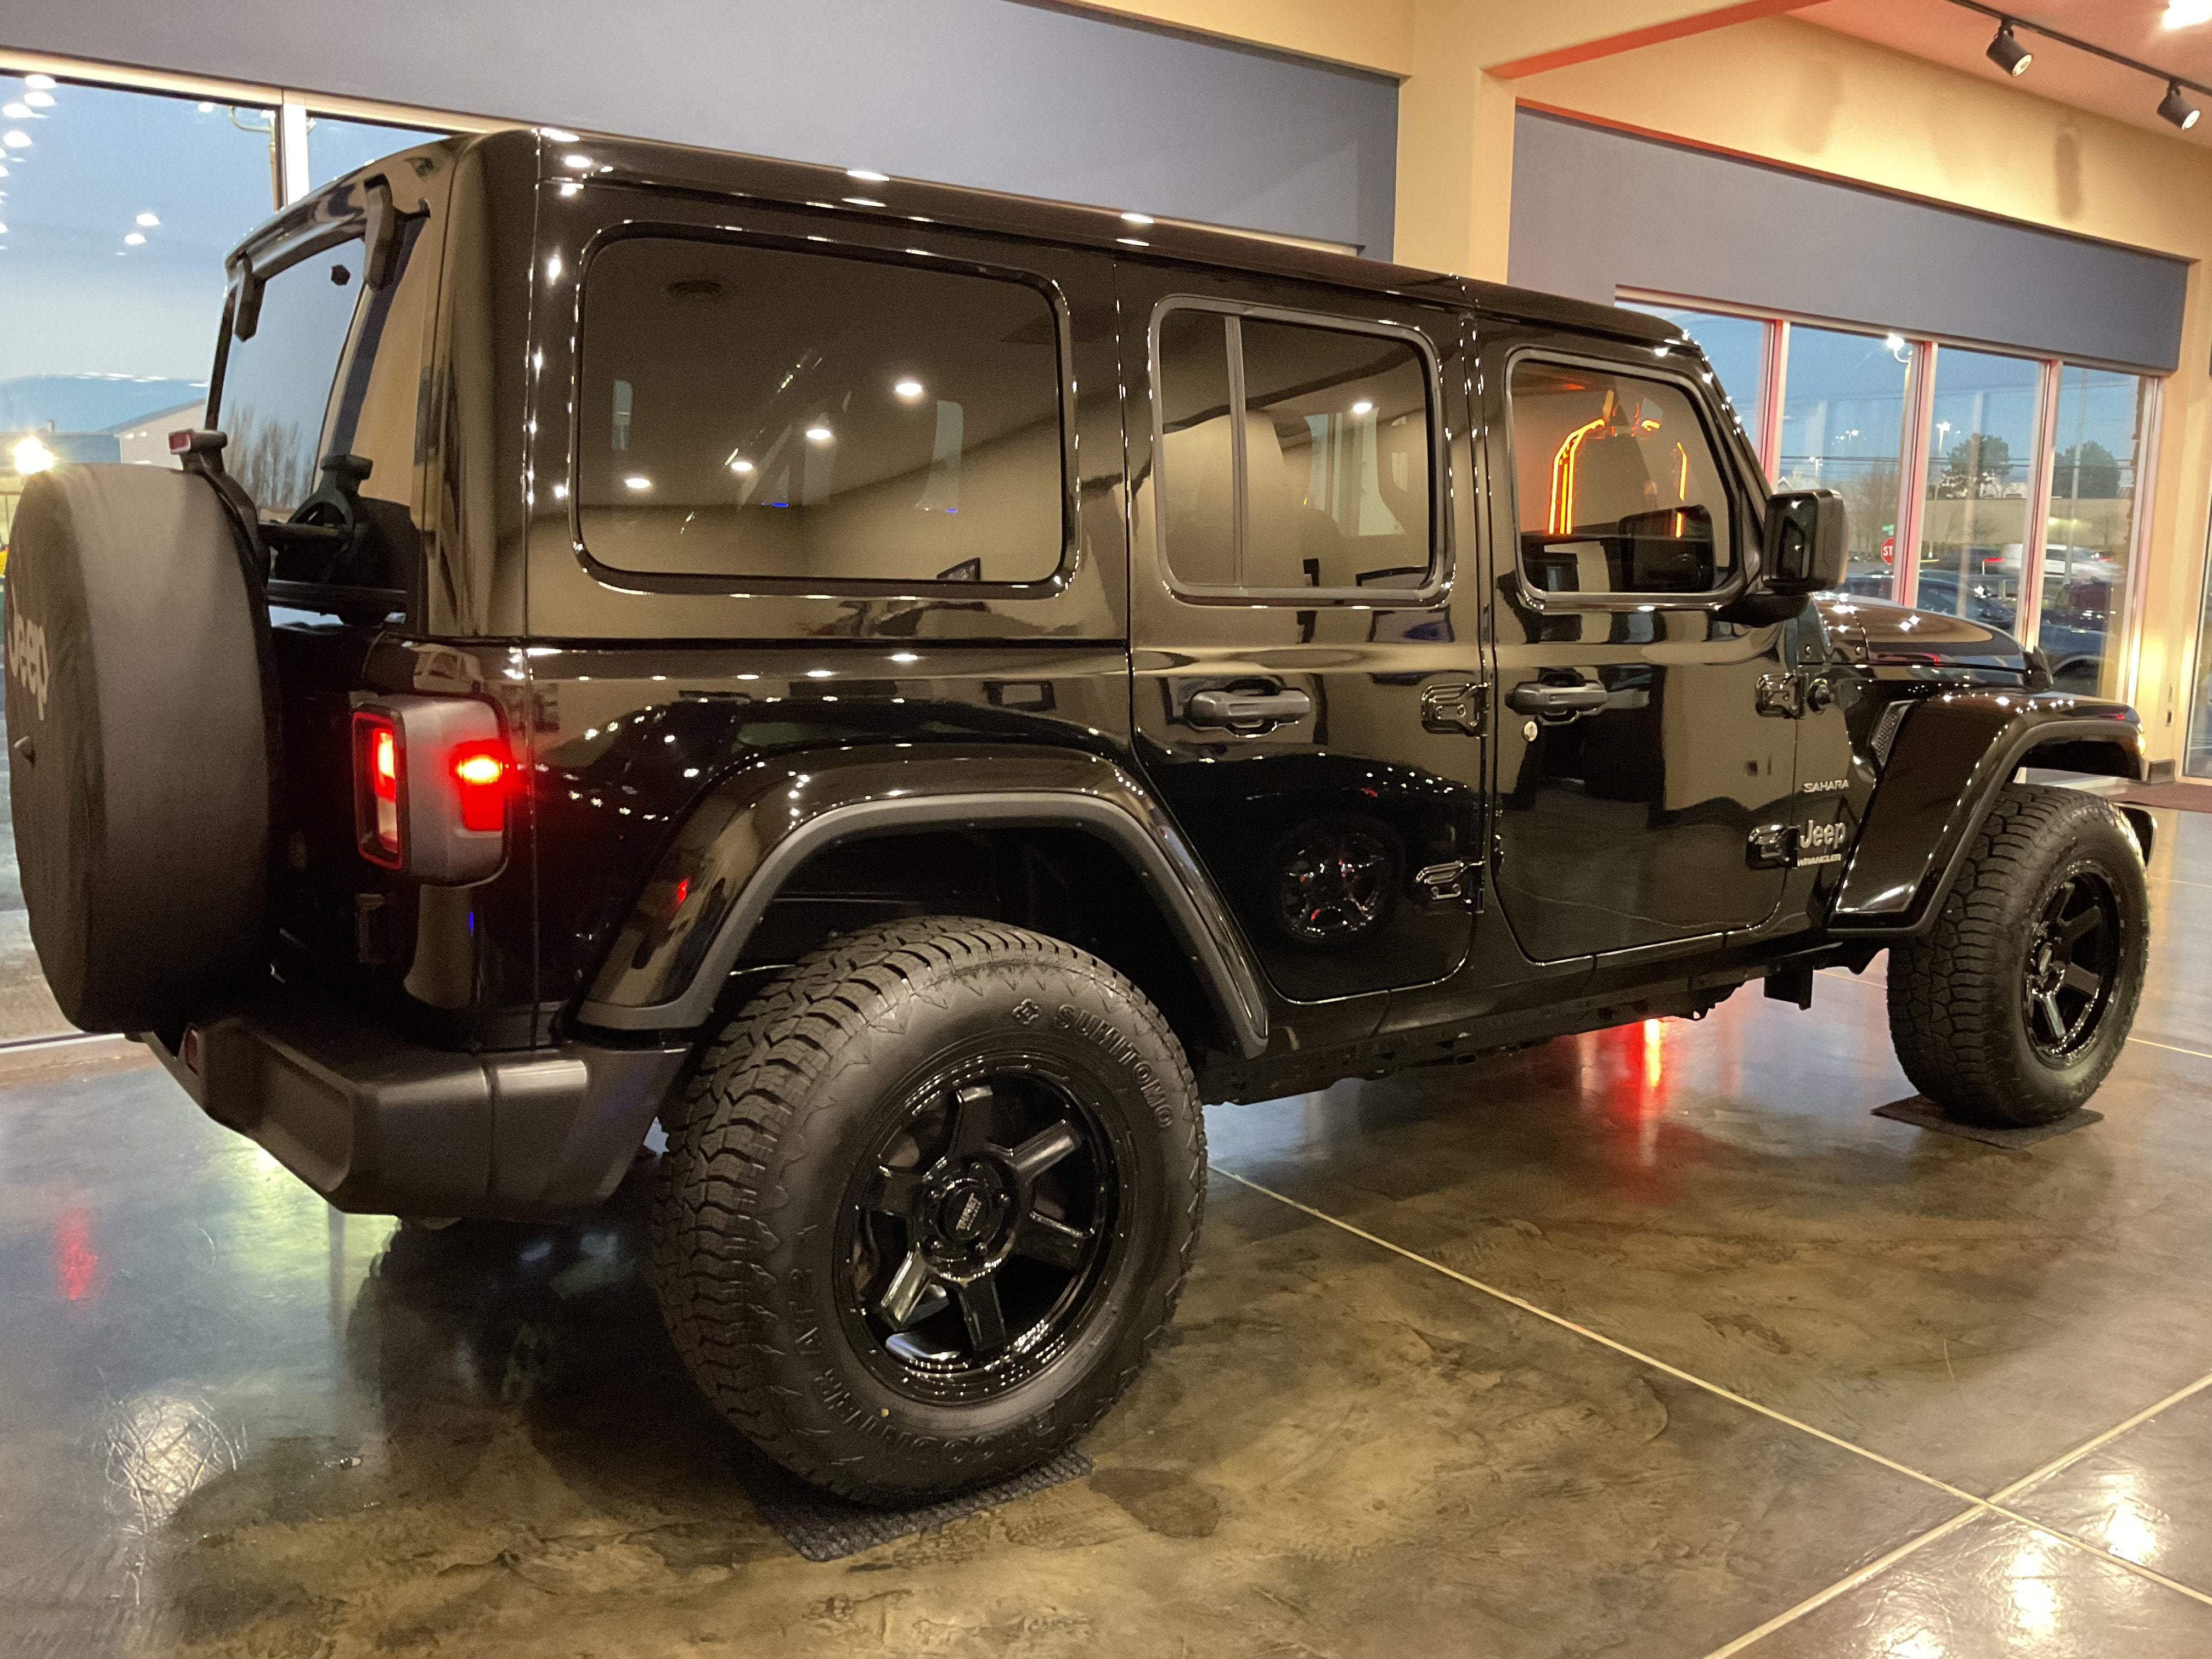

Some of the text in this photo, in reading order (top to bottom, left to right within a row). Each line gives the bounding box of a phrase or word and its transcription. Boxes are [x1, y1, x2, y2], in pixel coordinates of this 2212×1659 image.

[1883, 546, 1893, 556] ST
[8, 584, 49, 721] Jeep
[1803, 779, 1849, 793] SAHARA
[1799, 819, 1846, 849] Jeep
[1797, 854, 1841, 867] WRANGLER
[1054, 1004, 1173, 1128] SUMITOMO
